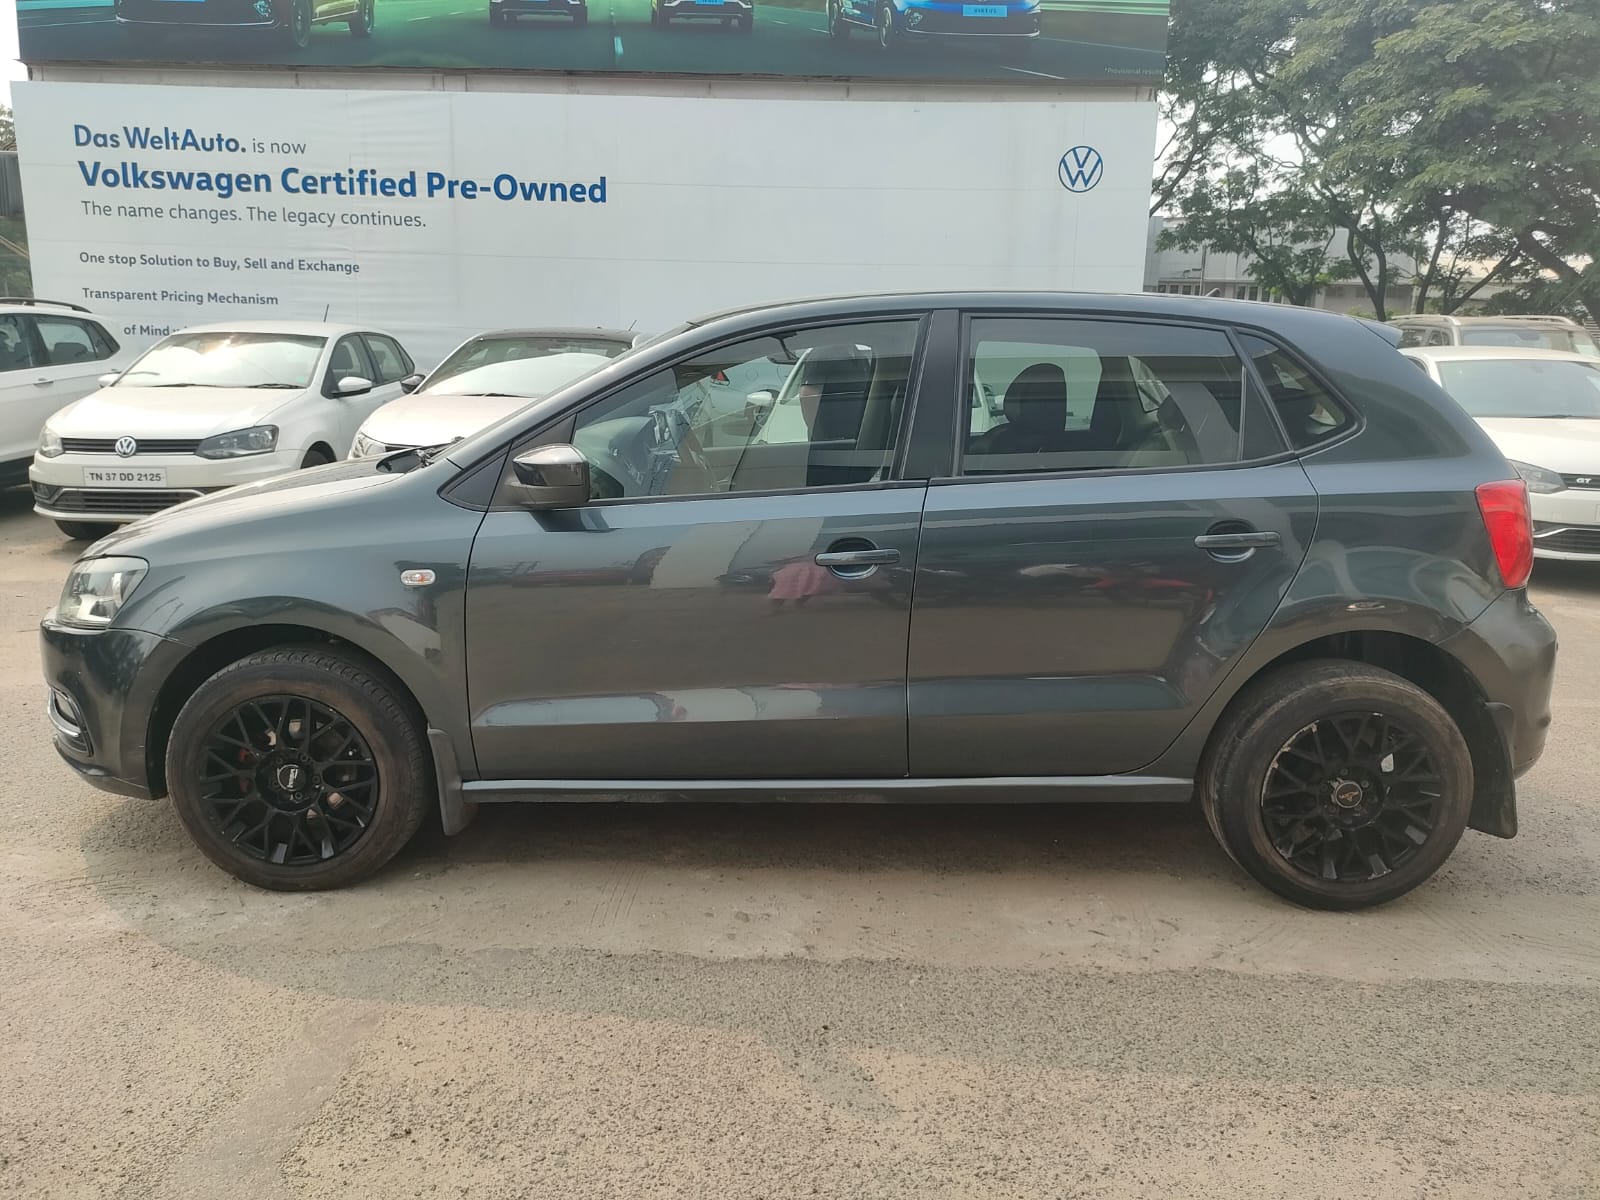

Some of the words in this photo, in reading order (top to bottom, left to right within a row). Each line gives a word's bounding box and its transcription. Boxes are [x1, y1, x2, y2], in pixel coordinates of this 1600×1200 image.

[74, 124, 120, 148] Das
[123, 126, 247, 153] WeltAuto.
[252, 138, 265, 153] is
[270, 142, 307, 154] now
[77, 160, 272, 199] Volkswagen
[281, 167, 417, 198] Certified
[426, 172, 607, 203] Pre-Owned
[81, 200, 112, 217] The
[117, 205, 164, 219] name
[168, 203, 242, 224] changes.
[246, 206, 277, 222] The
[282, 207, 336, 228] legacy
[340, 210, 427, 228] continues.
[79, 251, 105, 264] One
[108, 254, 137, 267] stop
[140, 254, 193, 267] Solution
[196, 257, 210, 268] to
[213, 256, 241, 271] Buy,
[244, 257, 268, 270] Sell
[270, 259, 295, 270] and
[298, 259, 360, 275] Exchange
[82, 287, 158, 302] Transparent
[161, 290, 204, 305] Pricing
[207, 292, 279, 305] Mechanism
[123, 324, 137, 335] of
[140, 325, 170, 336] Mind
[89, 472, 103, 481] TN
[105, 472, 117, 481] 37
[119, 472, 135, 481] DD
[136, 473, 162, 482] 2125
